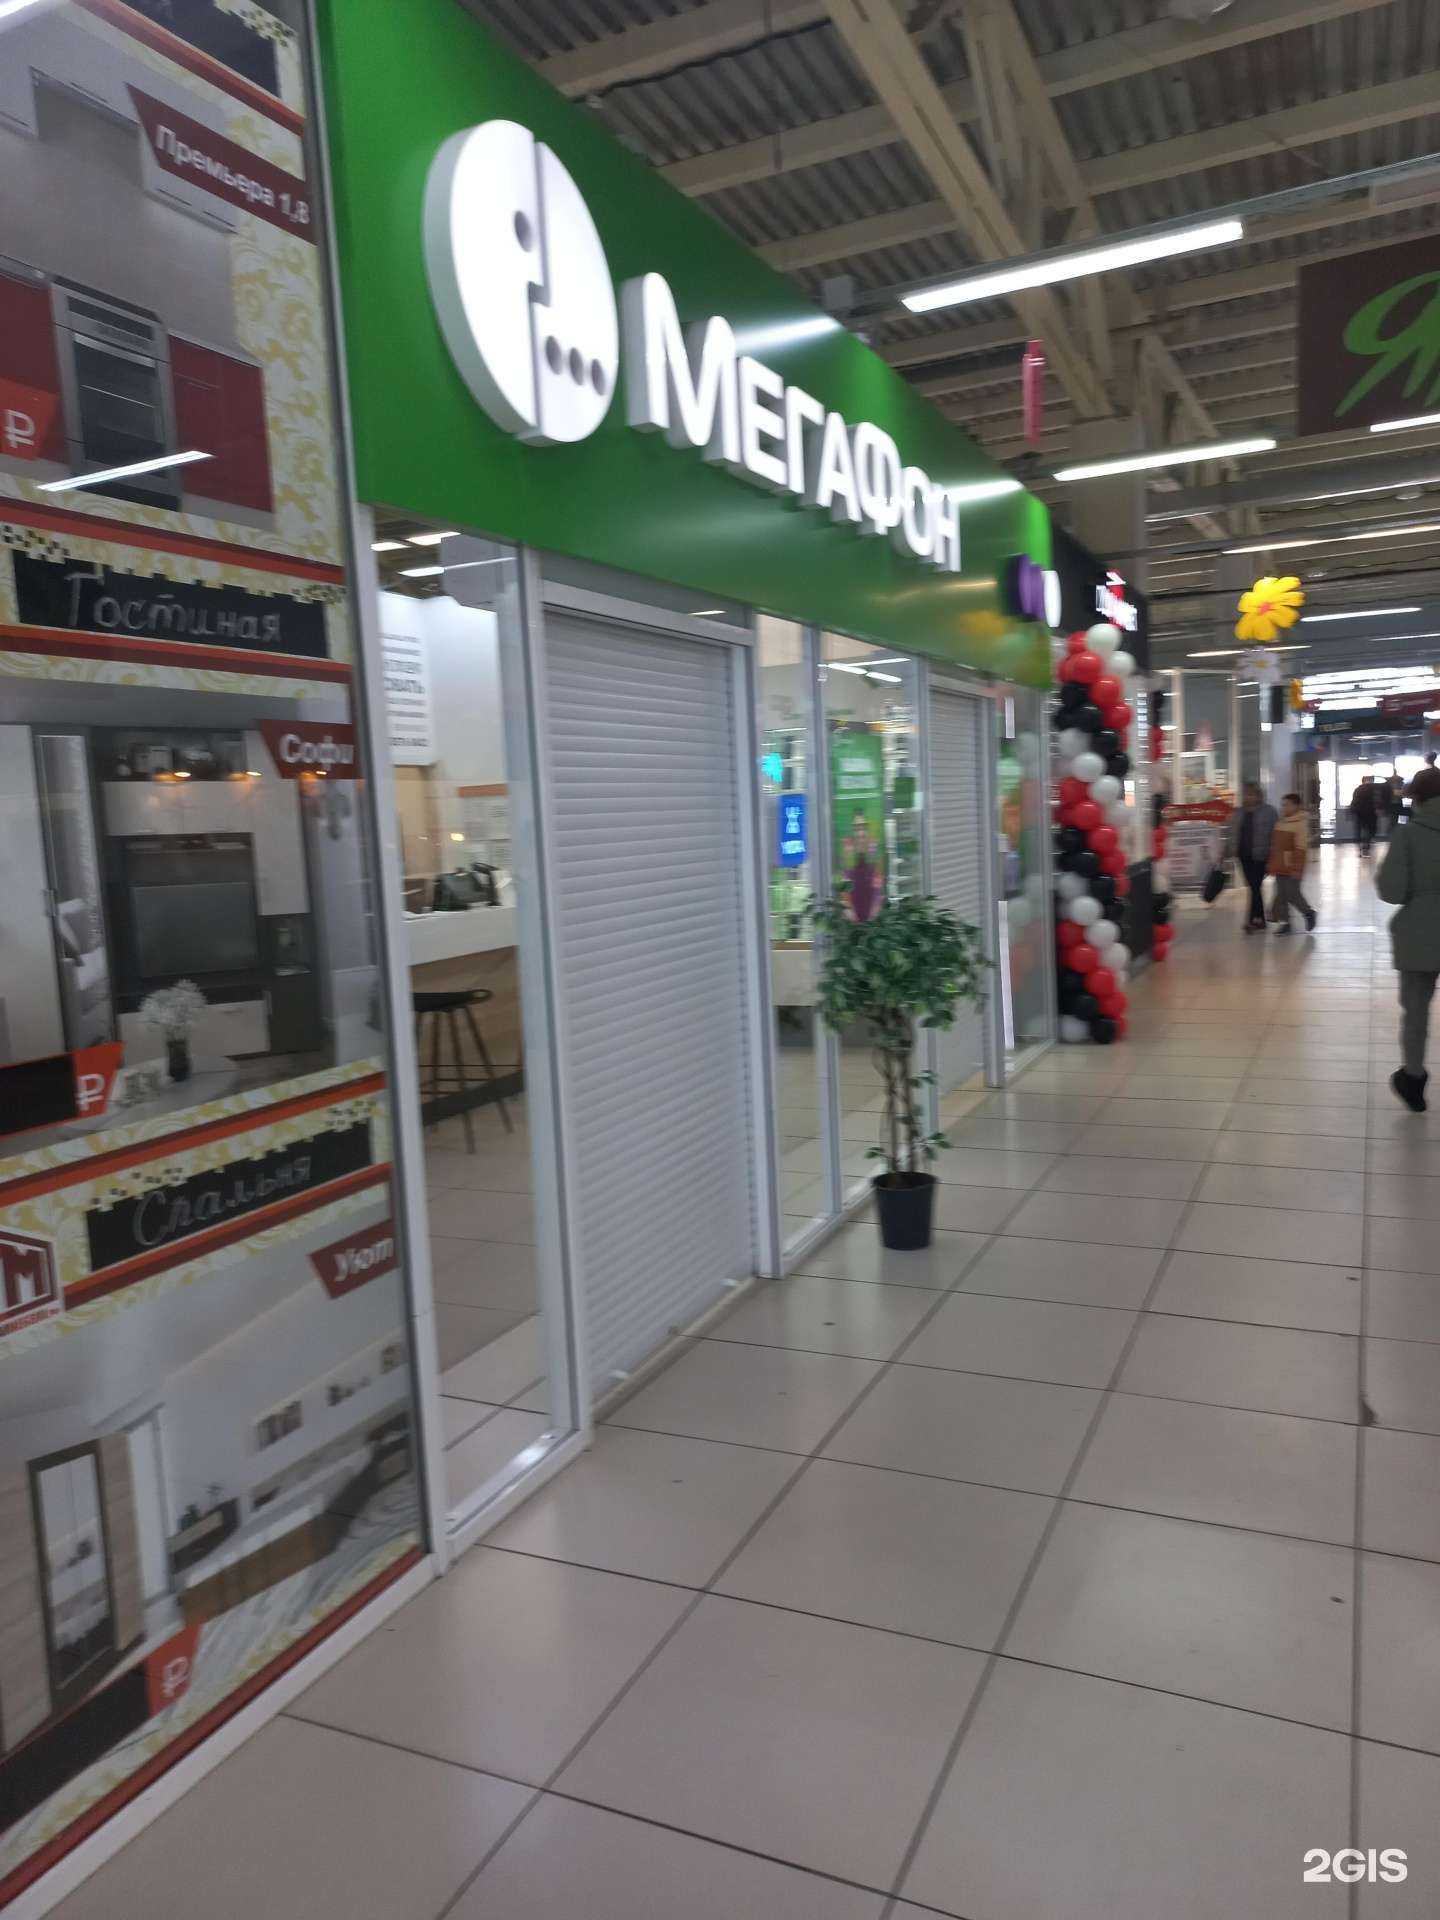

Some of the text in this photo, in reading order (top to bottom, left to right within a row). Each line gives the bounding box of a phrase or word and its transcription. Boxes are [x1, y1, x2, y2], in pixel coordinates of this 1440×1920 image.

[156, 125, 310, 225] Премьера 1,8
[64, 572, 281, 642] Гостиная
